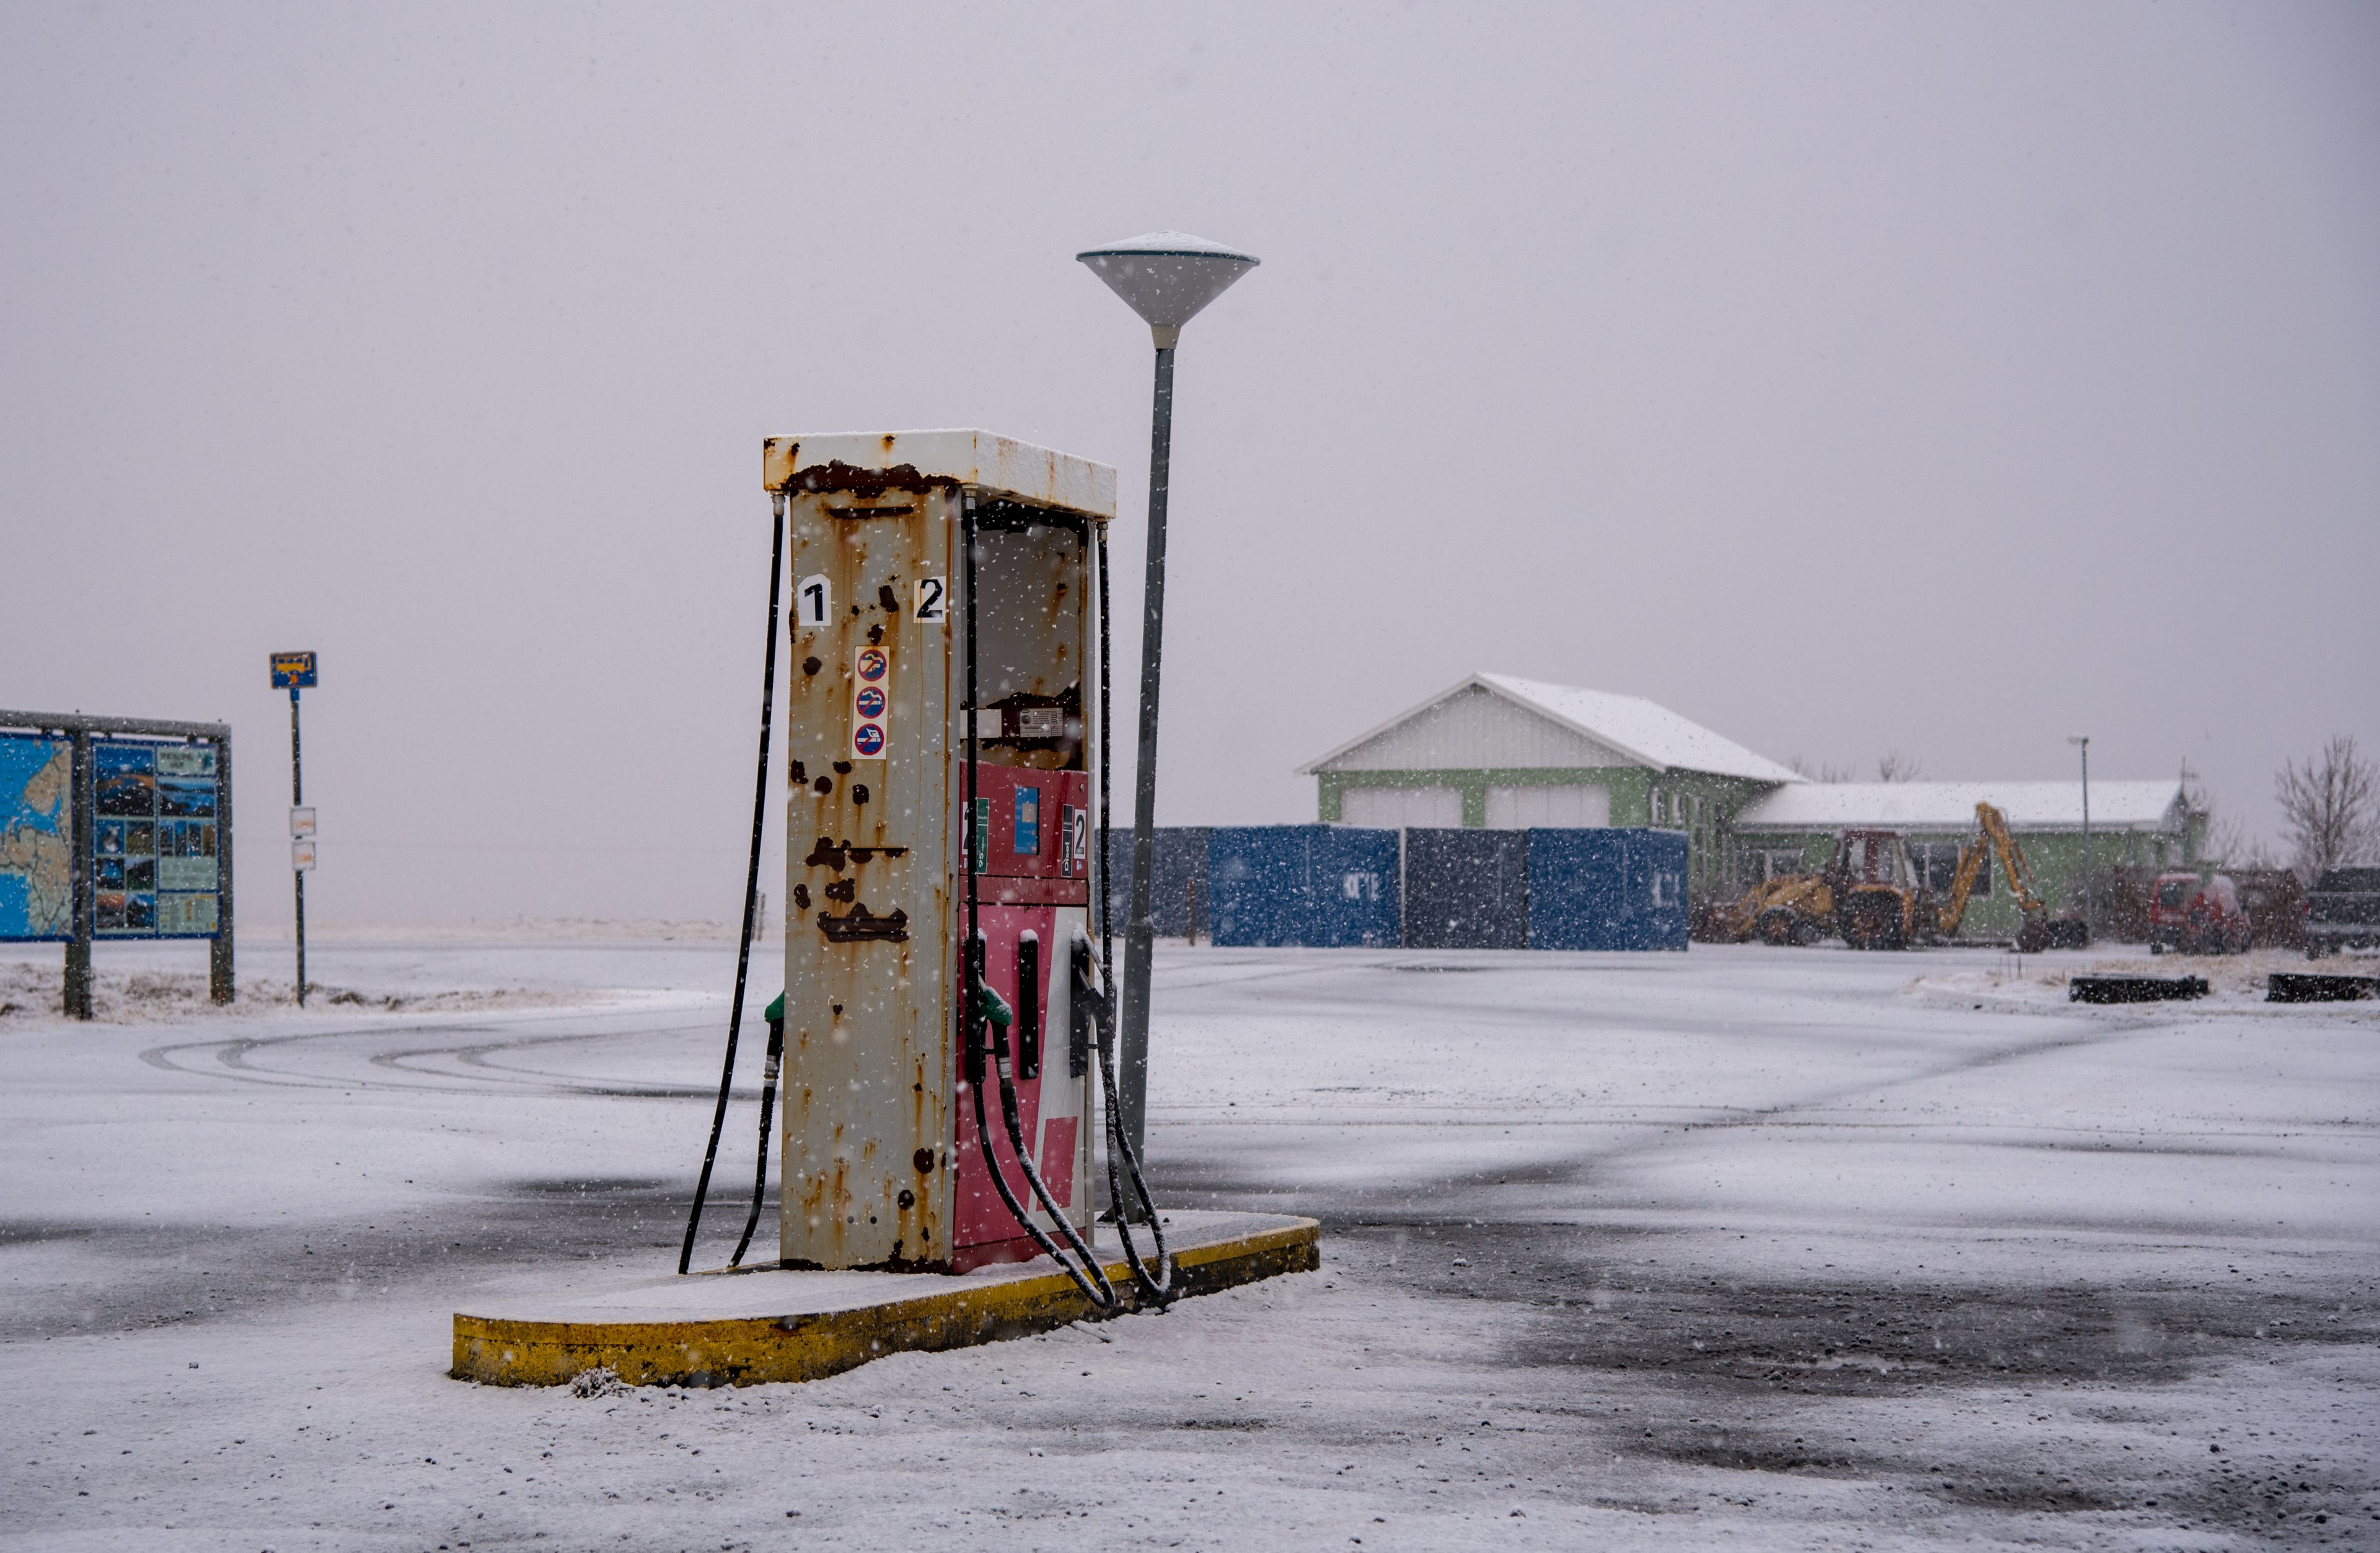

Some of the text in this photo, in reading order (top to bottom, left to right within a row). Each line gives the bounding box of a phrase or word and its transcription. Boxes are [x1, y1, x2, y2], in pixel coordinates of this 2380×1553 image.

[804, 583, 824, 622] 1
[917, 579, 943, 618] 2
[1075, 814, 1085, 854] 2
[979, 851, 984, 868] 95
